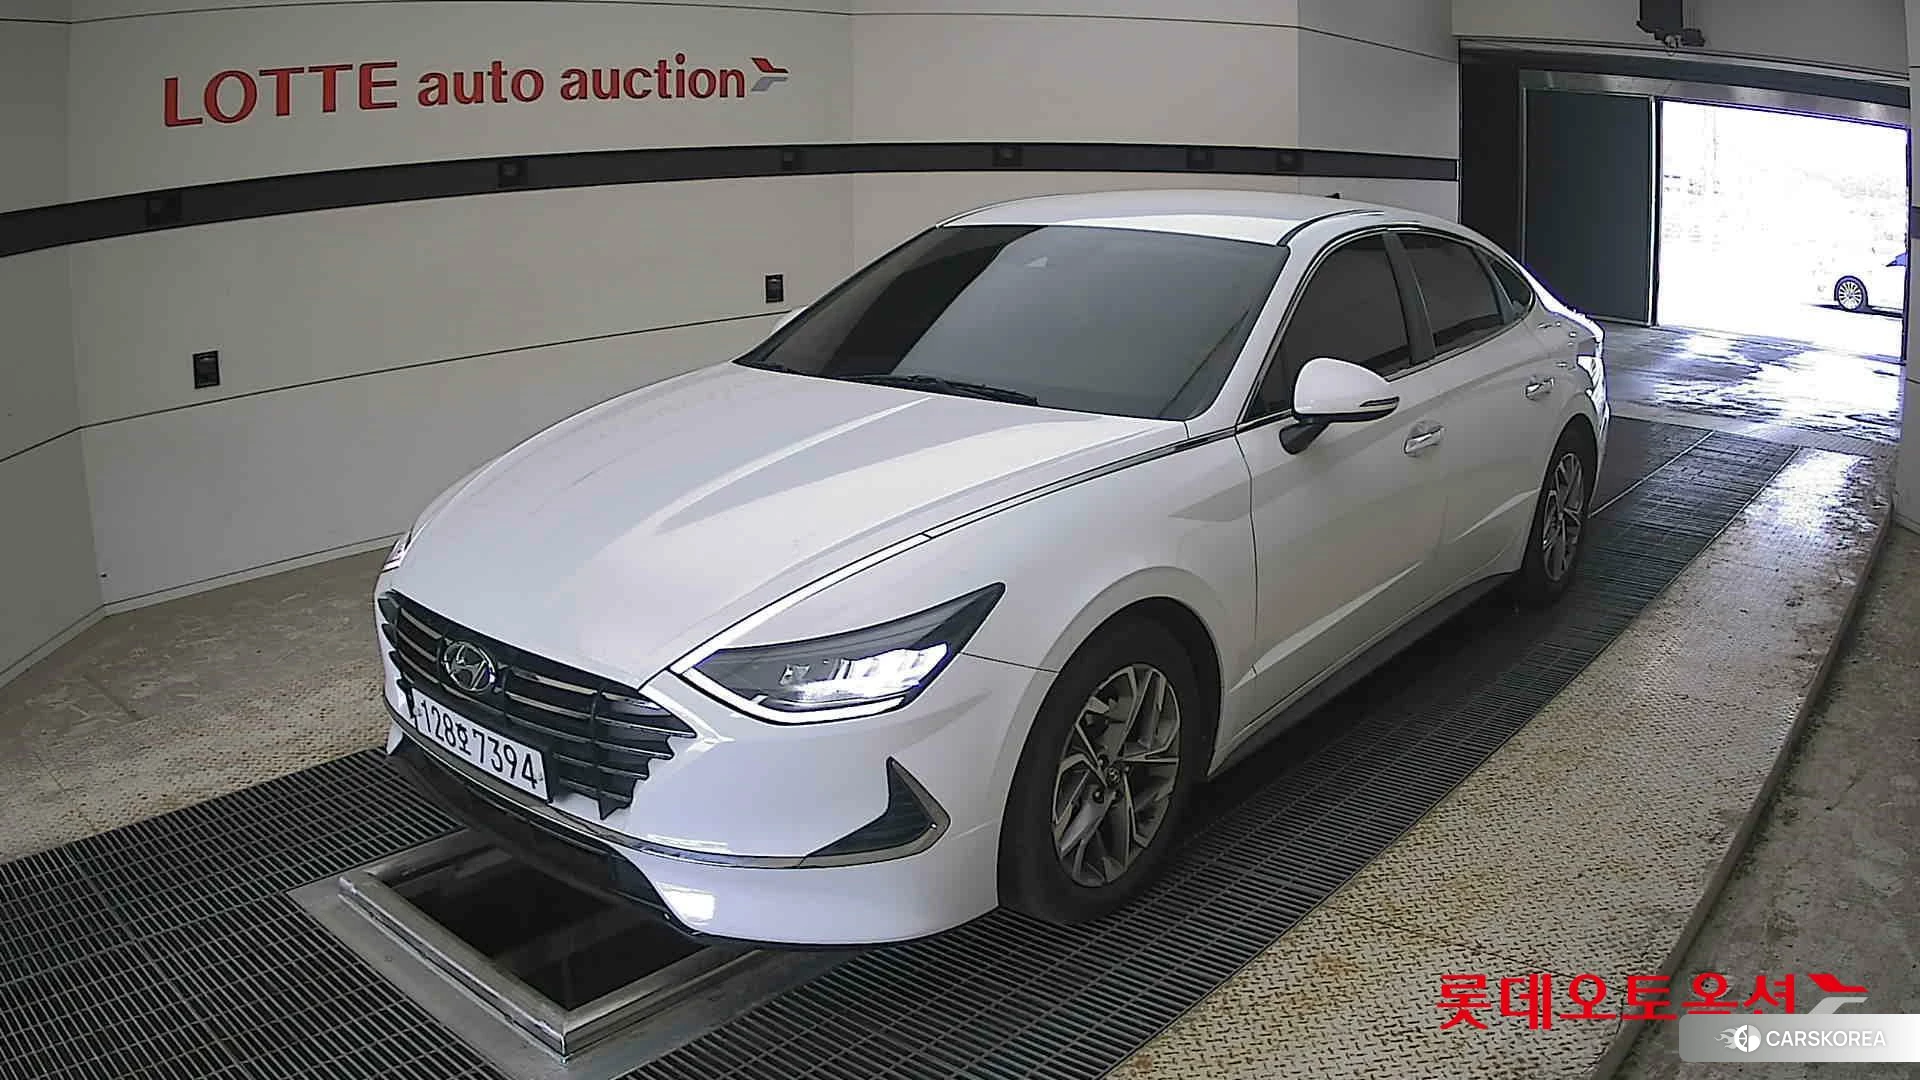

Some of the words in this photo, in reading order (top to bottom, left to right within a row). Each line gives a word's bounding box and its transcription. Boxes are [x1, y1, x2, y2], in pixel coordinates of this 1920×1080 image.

[163, 60, 398, 128] LOTTE
[417, 60, 545, 107] auto
[559, 52, 746, 101] auction
